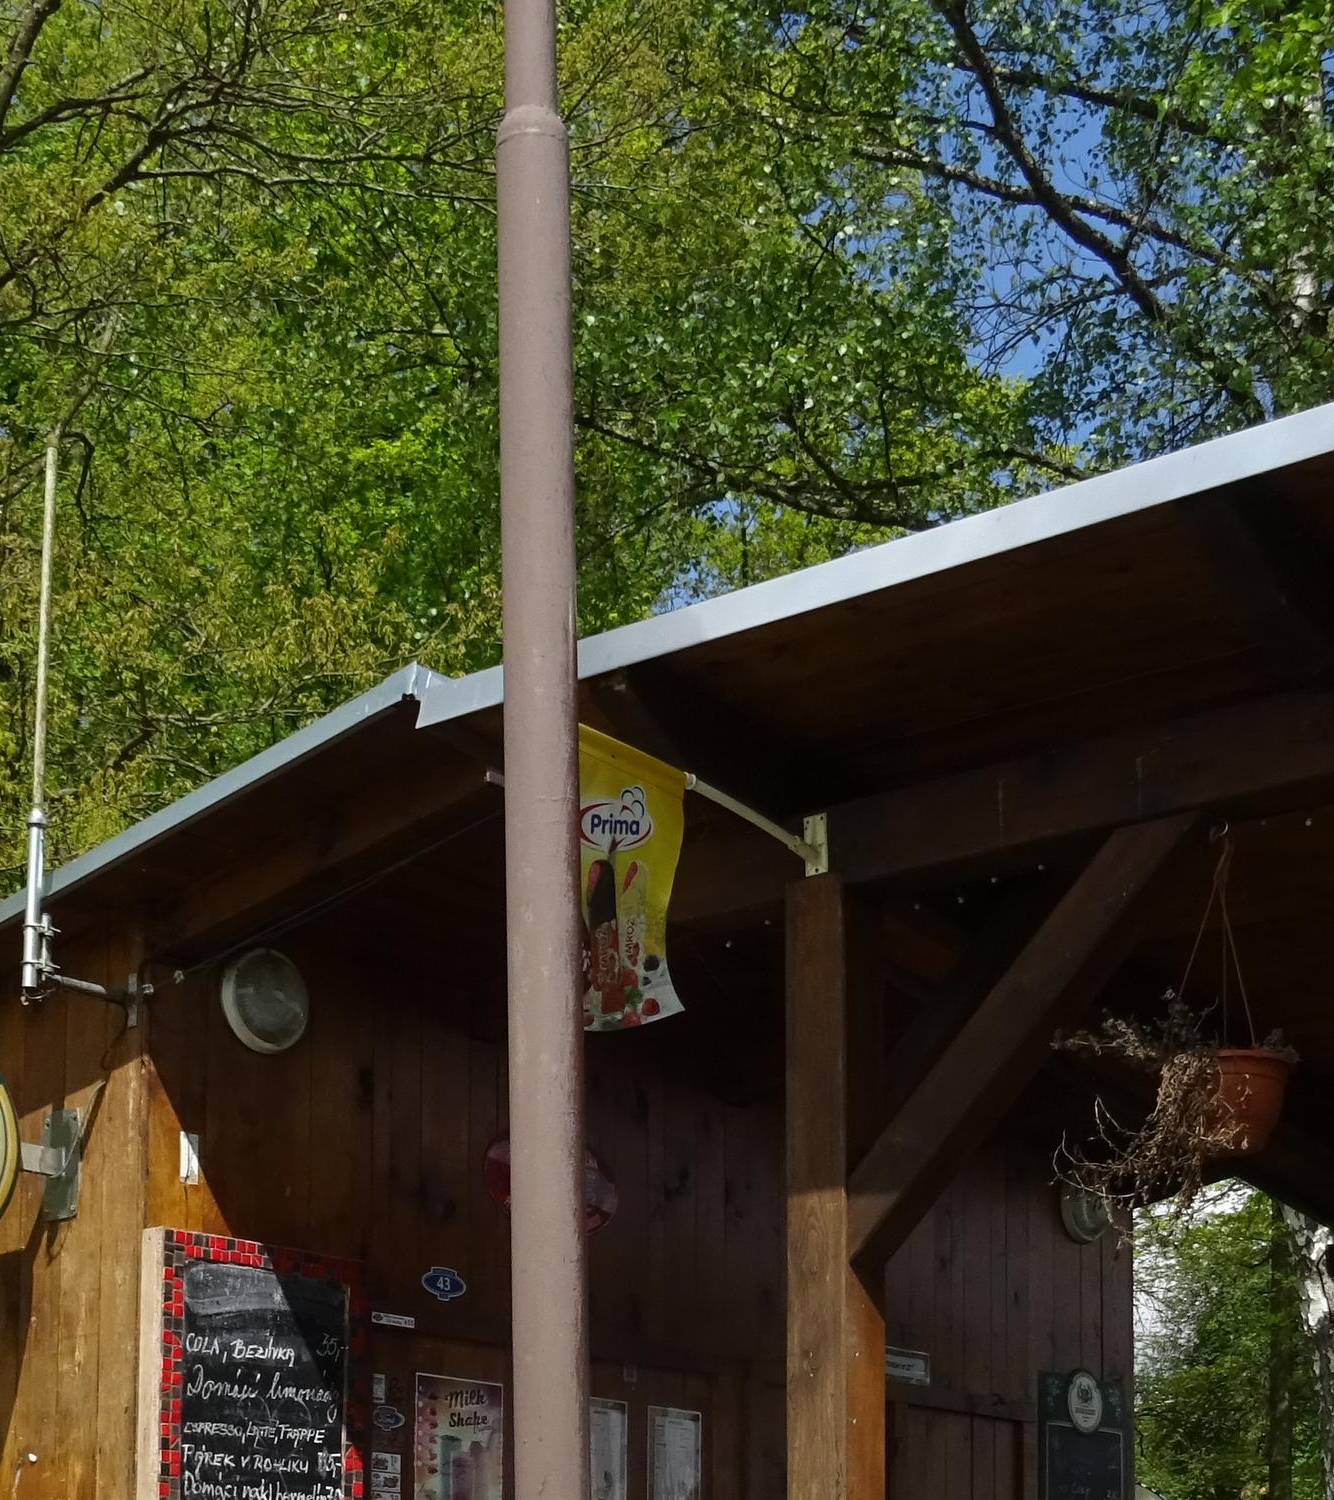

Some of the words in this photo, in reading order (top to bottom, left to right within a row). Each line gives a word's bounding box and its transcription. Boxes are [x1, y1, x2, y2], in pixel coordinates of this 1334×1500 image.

[590, 813, 640, 836] Prima
[436, 1277, 451, 1291] 43
[445, 1389, 486, 1409] Milk
[449, 1411, 488, 1428] Shake
